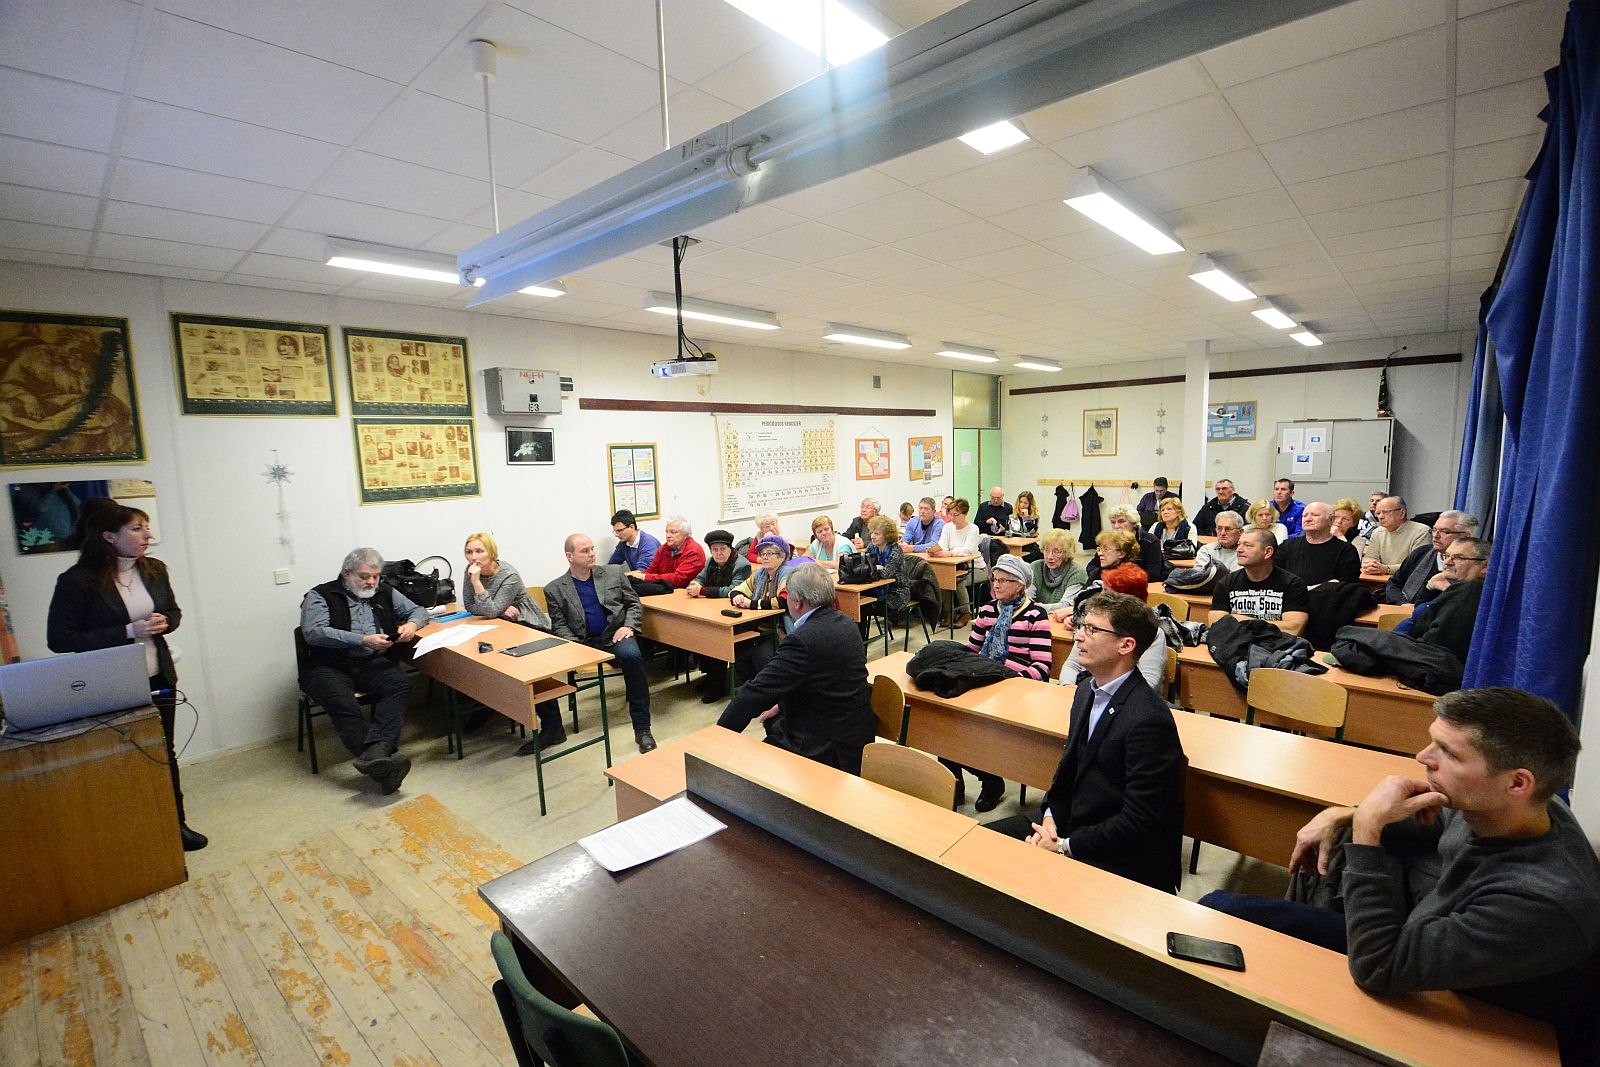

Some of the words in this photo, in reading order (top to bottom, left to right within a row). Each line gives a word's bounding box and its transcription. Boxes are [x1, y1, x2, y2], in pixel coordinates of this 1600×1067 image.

[528, 403, 540, 412] E3
[1248, 588, 1266, 596] World
[1230, 598, 1257, 610] Motor
